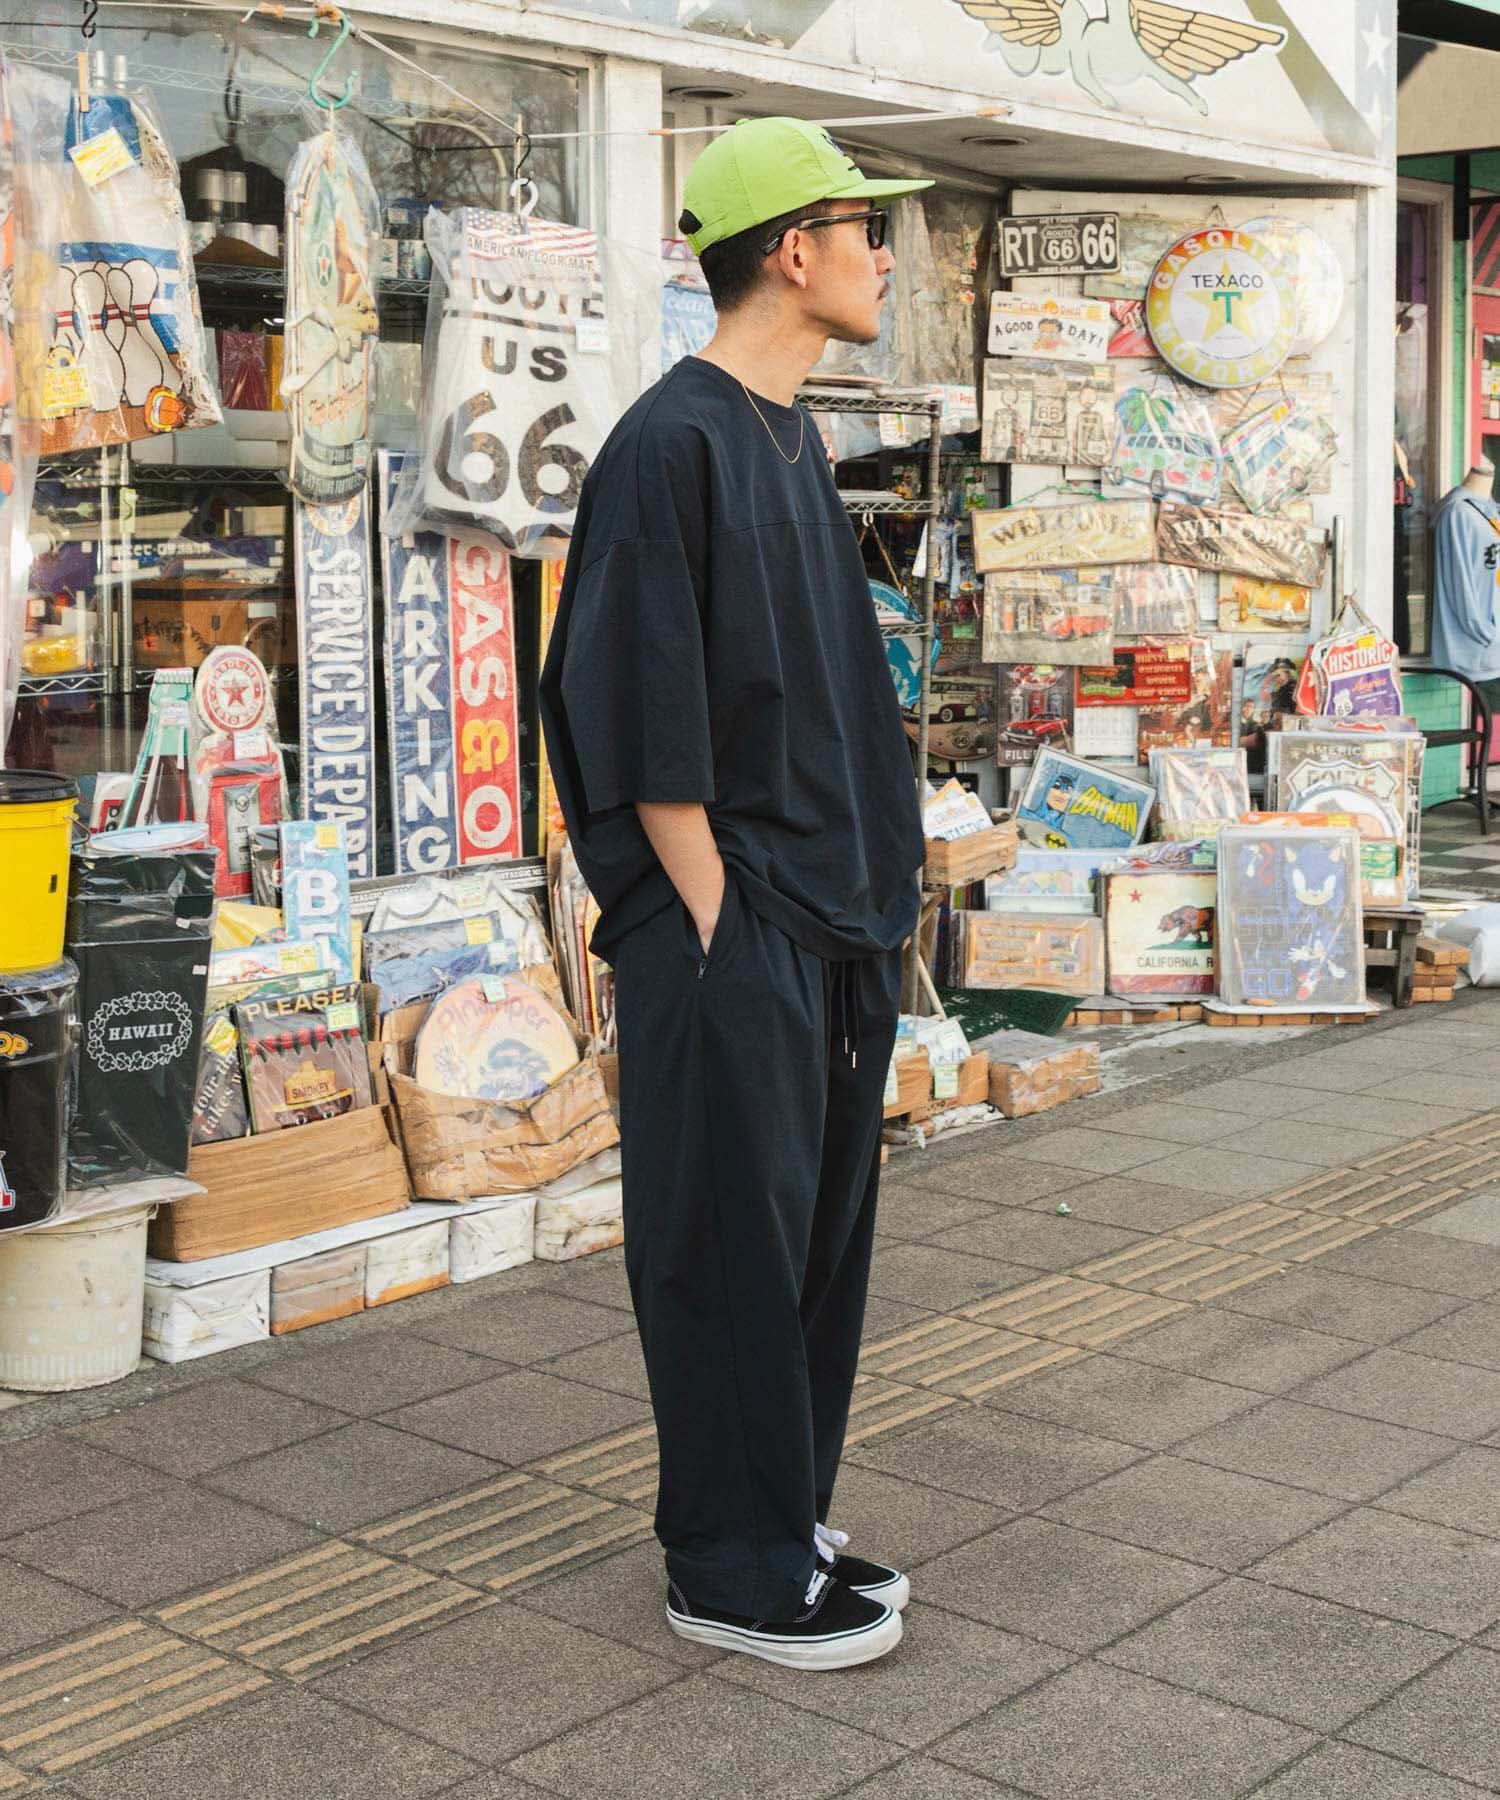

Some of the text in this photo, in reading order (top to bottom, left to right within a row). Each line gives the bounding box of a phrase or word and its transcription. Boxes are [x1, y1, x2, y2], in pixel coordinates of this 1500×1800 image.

[467, 236, 528, 258] AMERICAN
[1004, 226, 1037, 267] RT
[1047, 239, 1074, 260] 66
[1082, 223, 1116, 264] 66
[1192, 274, 1264, 289] TEXACO
[1212, 291, 1242, 324] T
[995, 321, 1034, 337] A GOOD
[1068, 324, 1104, 348] DAY!
[479, 333, 569, 383] US
[432, 390, 588, 514] 66
[306, 547, 366, 714] SERVICE
[455, 540, 508, 707] GAS
[1328, 642, 1392, 674] HISTORIC
[460, 718, 510, 776] &
[1004, 748, 1031, 761] FILL
[1069, 785, 1138, 837] BATMAN
[1136, 957, 1199, 969] CALIFORNIA
[246, 985, 357, 1022] PLEASE!
[108, 1022, 174, 1041] HAWAII
[291, 1082, 330, 1099] SMOKEY
